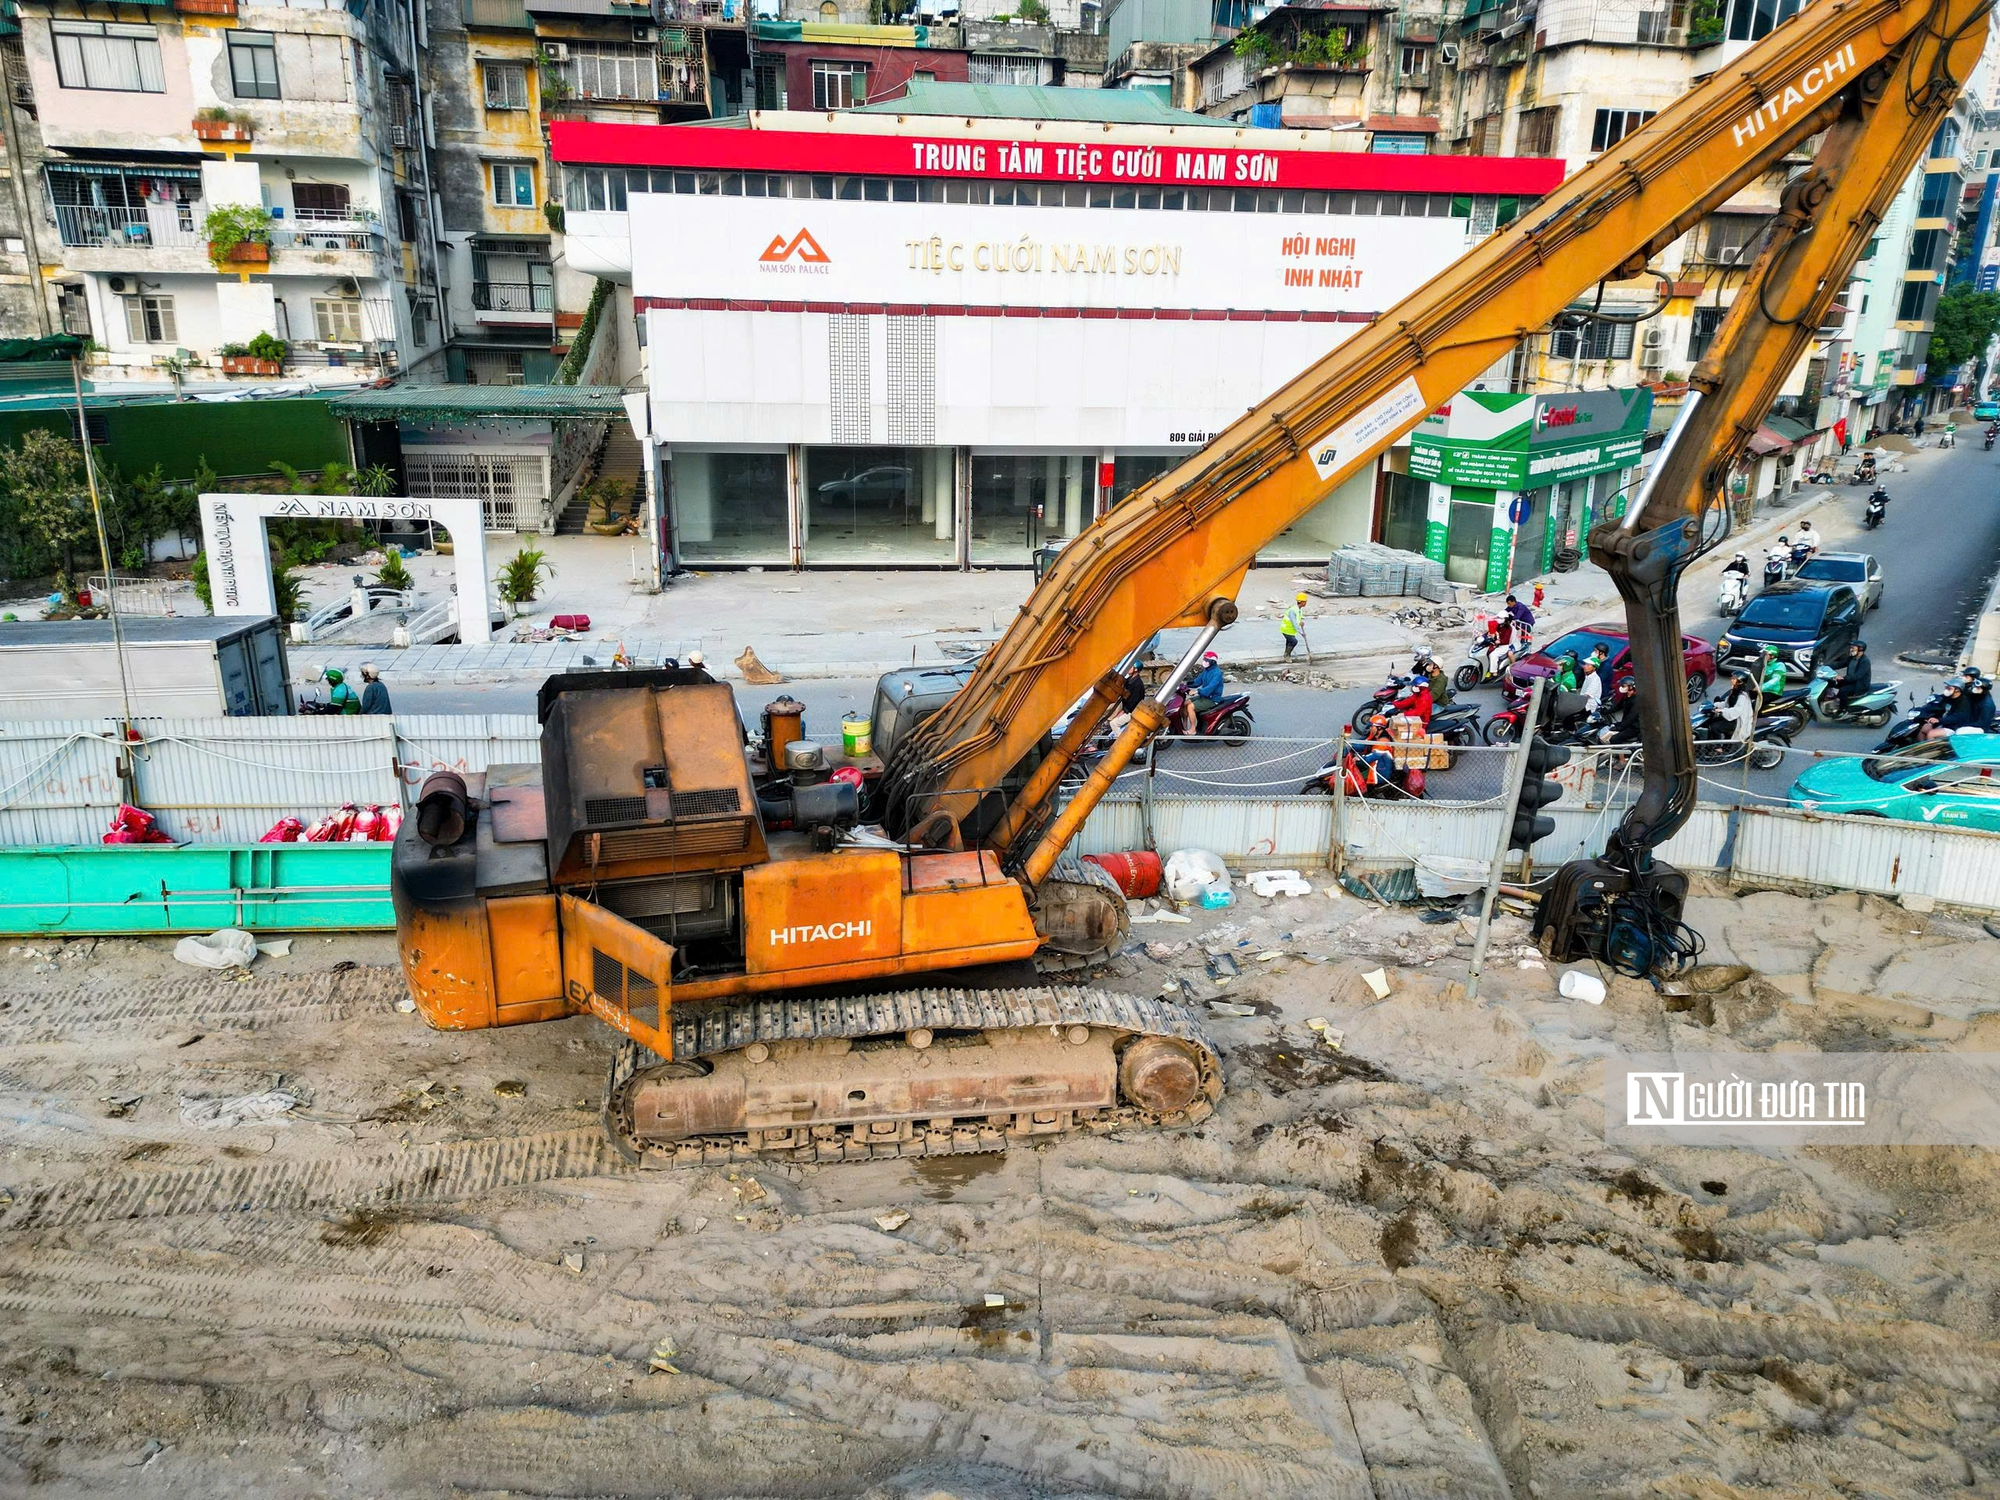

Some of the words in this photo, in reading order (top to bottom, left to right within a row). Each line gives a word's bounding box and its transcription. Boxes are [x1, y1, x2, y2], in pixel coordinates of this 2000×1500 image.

[1732, 43, 1856, 147] HITACHI
[912, 143, 986, 172] TRUNG
[997, 141, 1043, 174] TÂM
[1055, 144, 1102, 180] TIỆC
[1112, 145, 1162, 178] CƯỚI
[1175, 153, 1226, 180] NAM
[1235, 153, 1279, 182] SƠN
[905, 232, 964, 275] TIỆC
[972, 233, 1043, 273] CƯỚI
[1051, 243, 1117, 274] NAM
[1124, 244, 1183, 276] SƠN
[1282, 232, 1310, 259] HỘI
[1315, 237, 1356, 260] NGHỊ
[759, 264, 778, 273] NAM
[780, 263, 796, 273] SƠN
[799, 264, 829, 275] PALACE
[1319, 265, 1363, 292] NHẬT
[1169, 432, 1186, 442] 809
[1188, 429, 1206, 442] GIẢI
[213, 501, 234, 527] KIẾN
[317, 501, 377, 517] NAM
[382, 501, 432, 518] SƠN
[214, 527, 232, 548] TẠO
[217, 549, 235, 577] HẠNH
[770, 919, 871, 946] HITACHI
